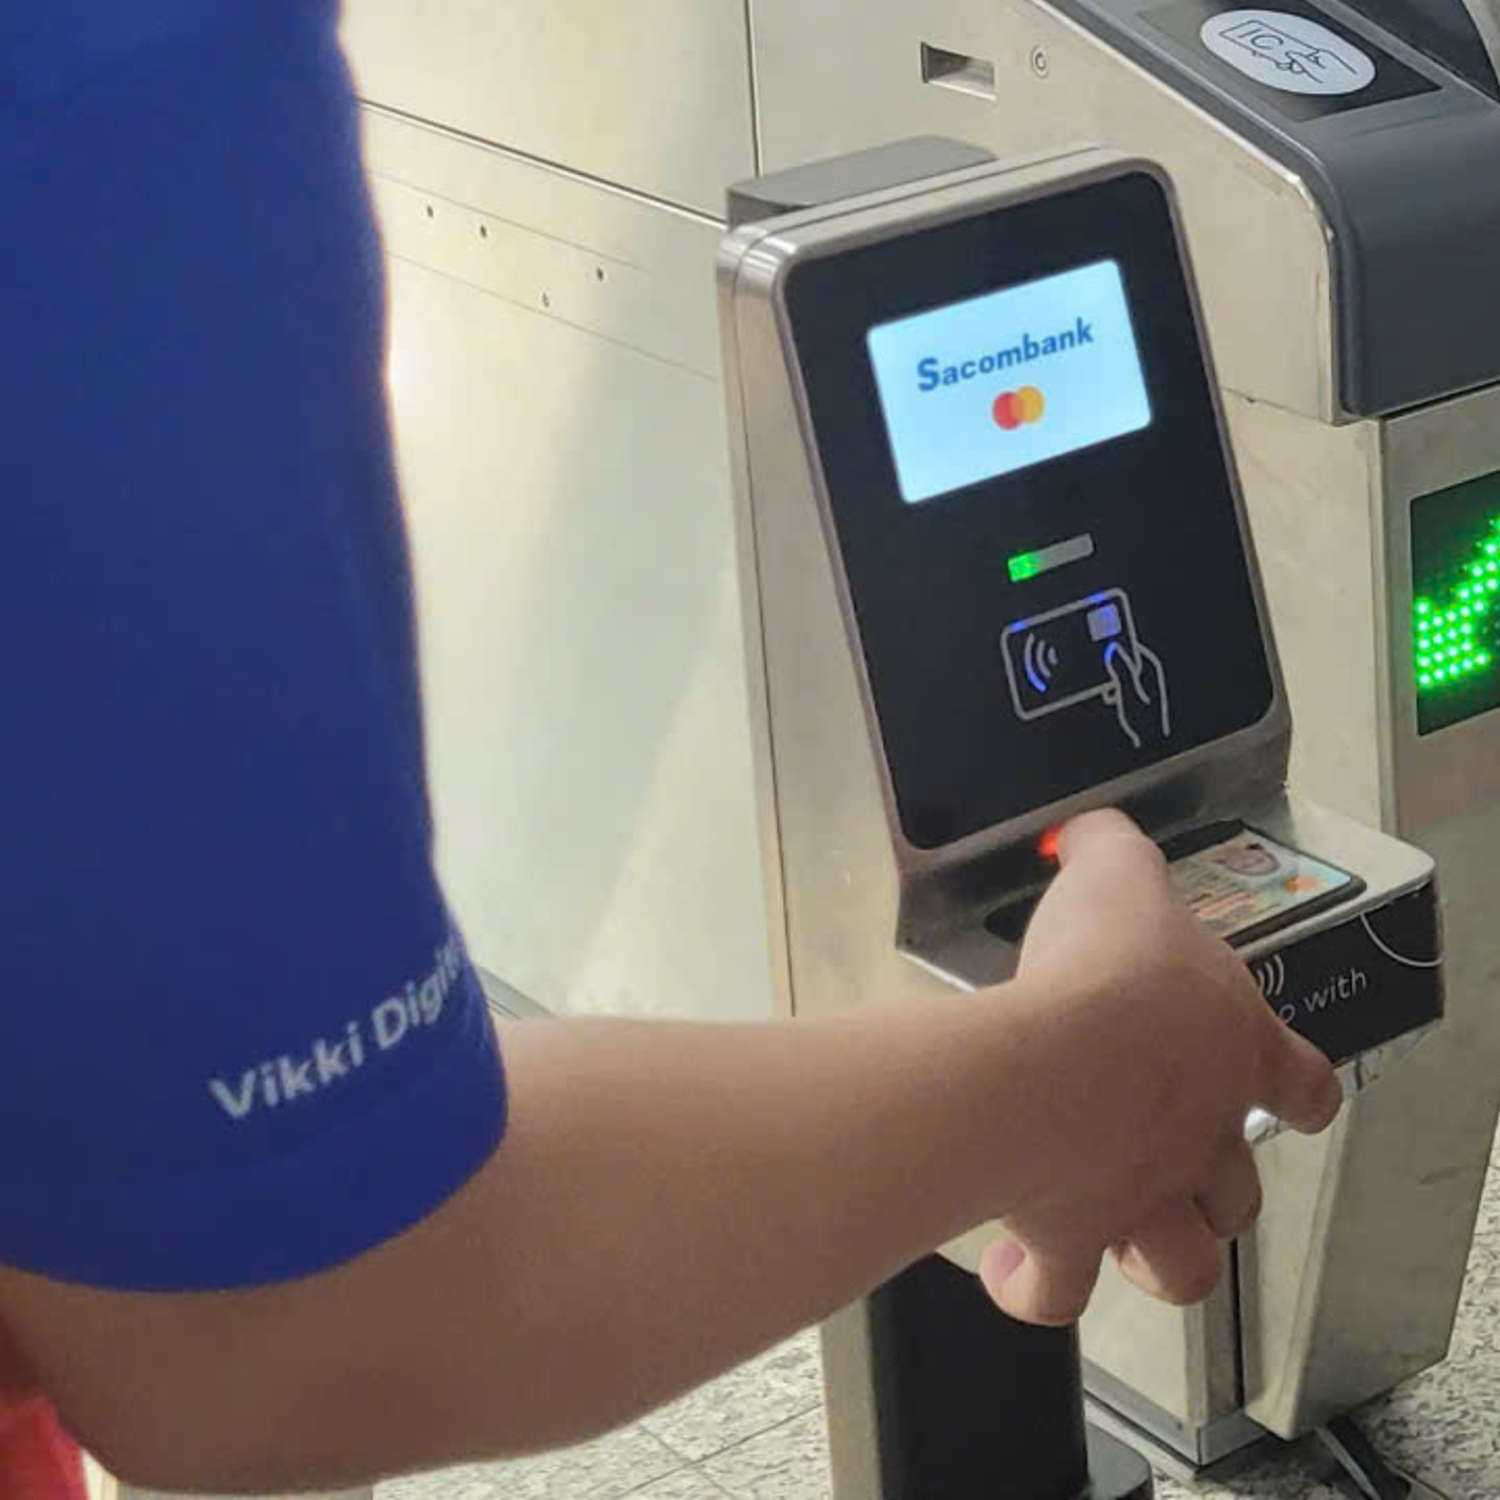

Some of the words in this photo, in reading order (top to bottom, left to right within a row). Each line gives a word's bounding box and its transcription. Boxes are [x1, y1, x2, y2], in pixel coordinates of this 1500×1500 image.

[1238, 28, 1284, 50] IC
[916, 317, 1094, 391] Sacombank
[1303, 967, 1367, 1014] with
[209, 1020, 365, 1118] Vikki
